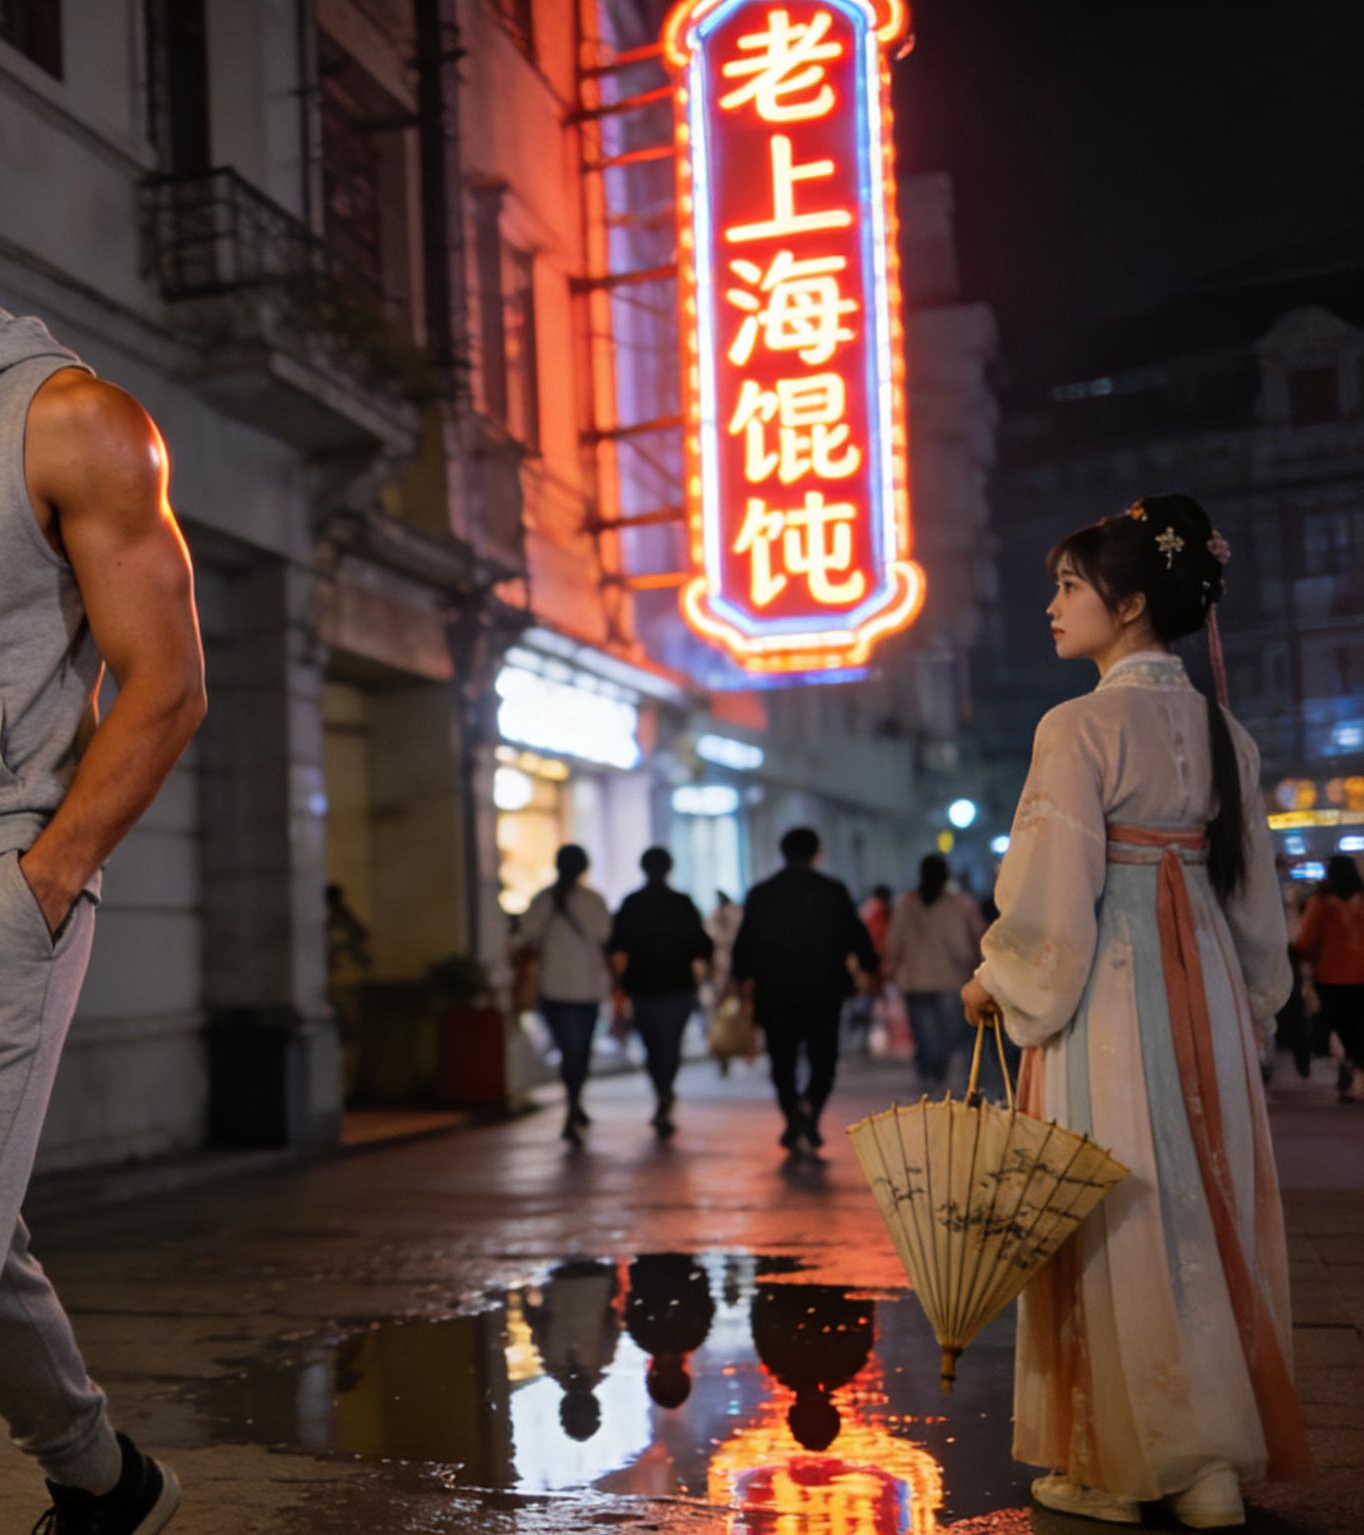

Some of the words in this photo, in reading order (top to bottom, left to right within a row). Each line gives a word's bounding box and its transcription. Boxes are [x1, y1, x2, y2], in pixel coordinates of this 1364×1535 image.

[719, 10, 865, 606] 老上海馄饨
